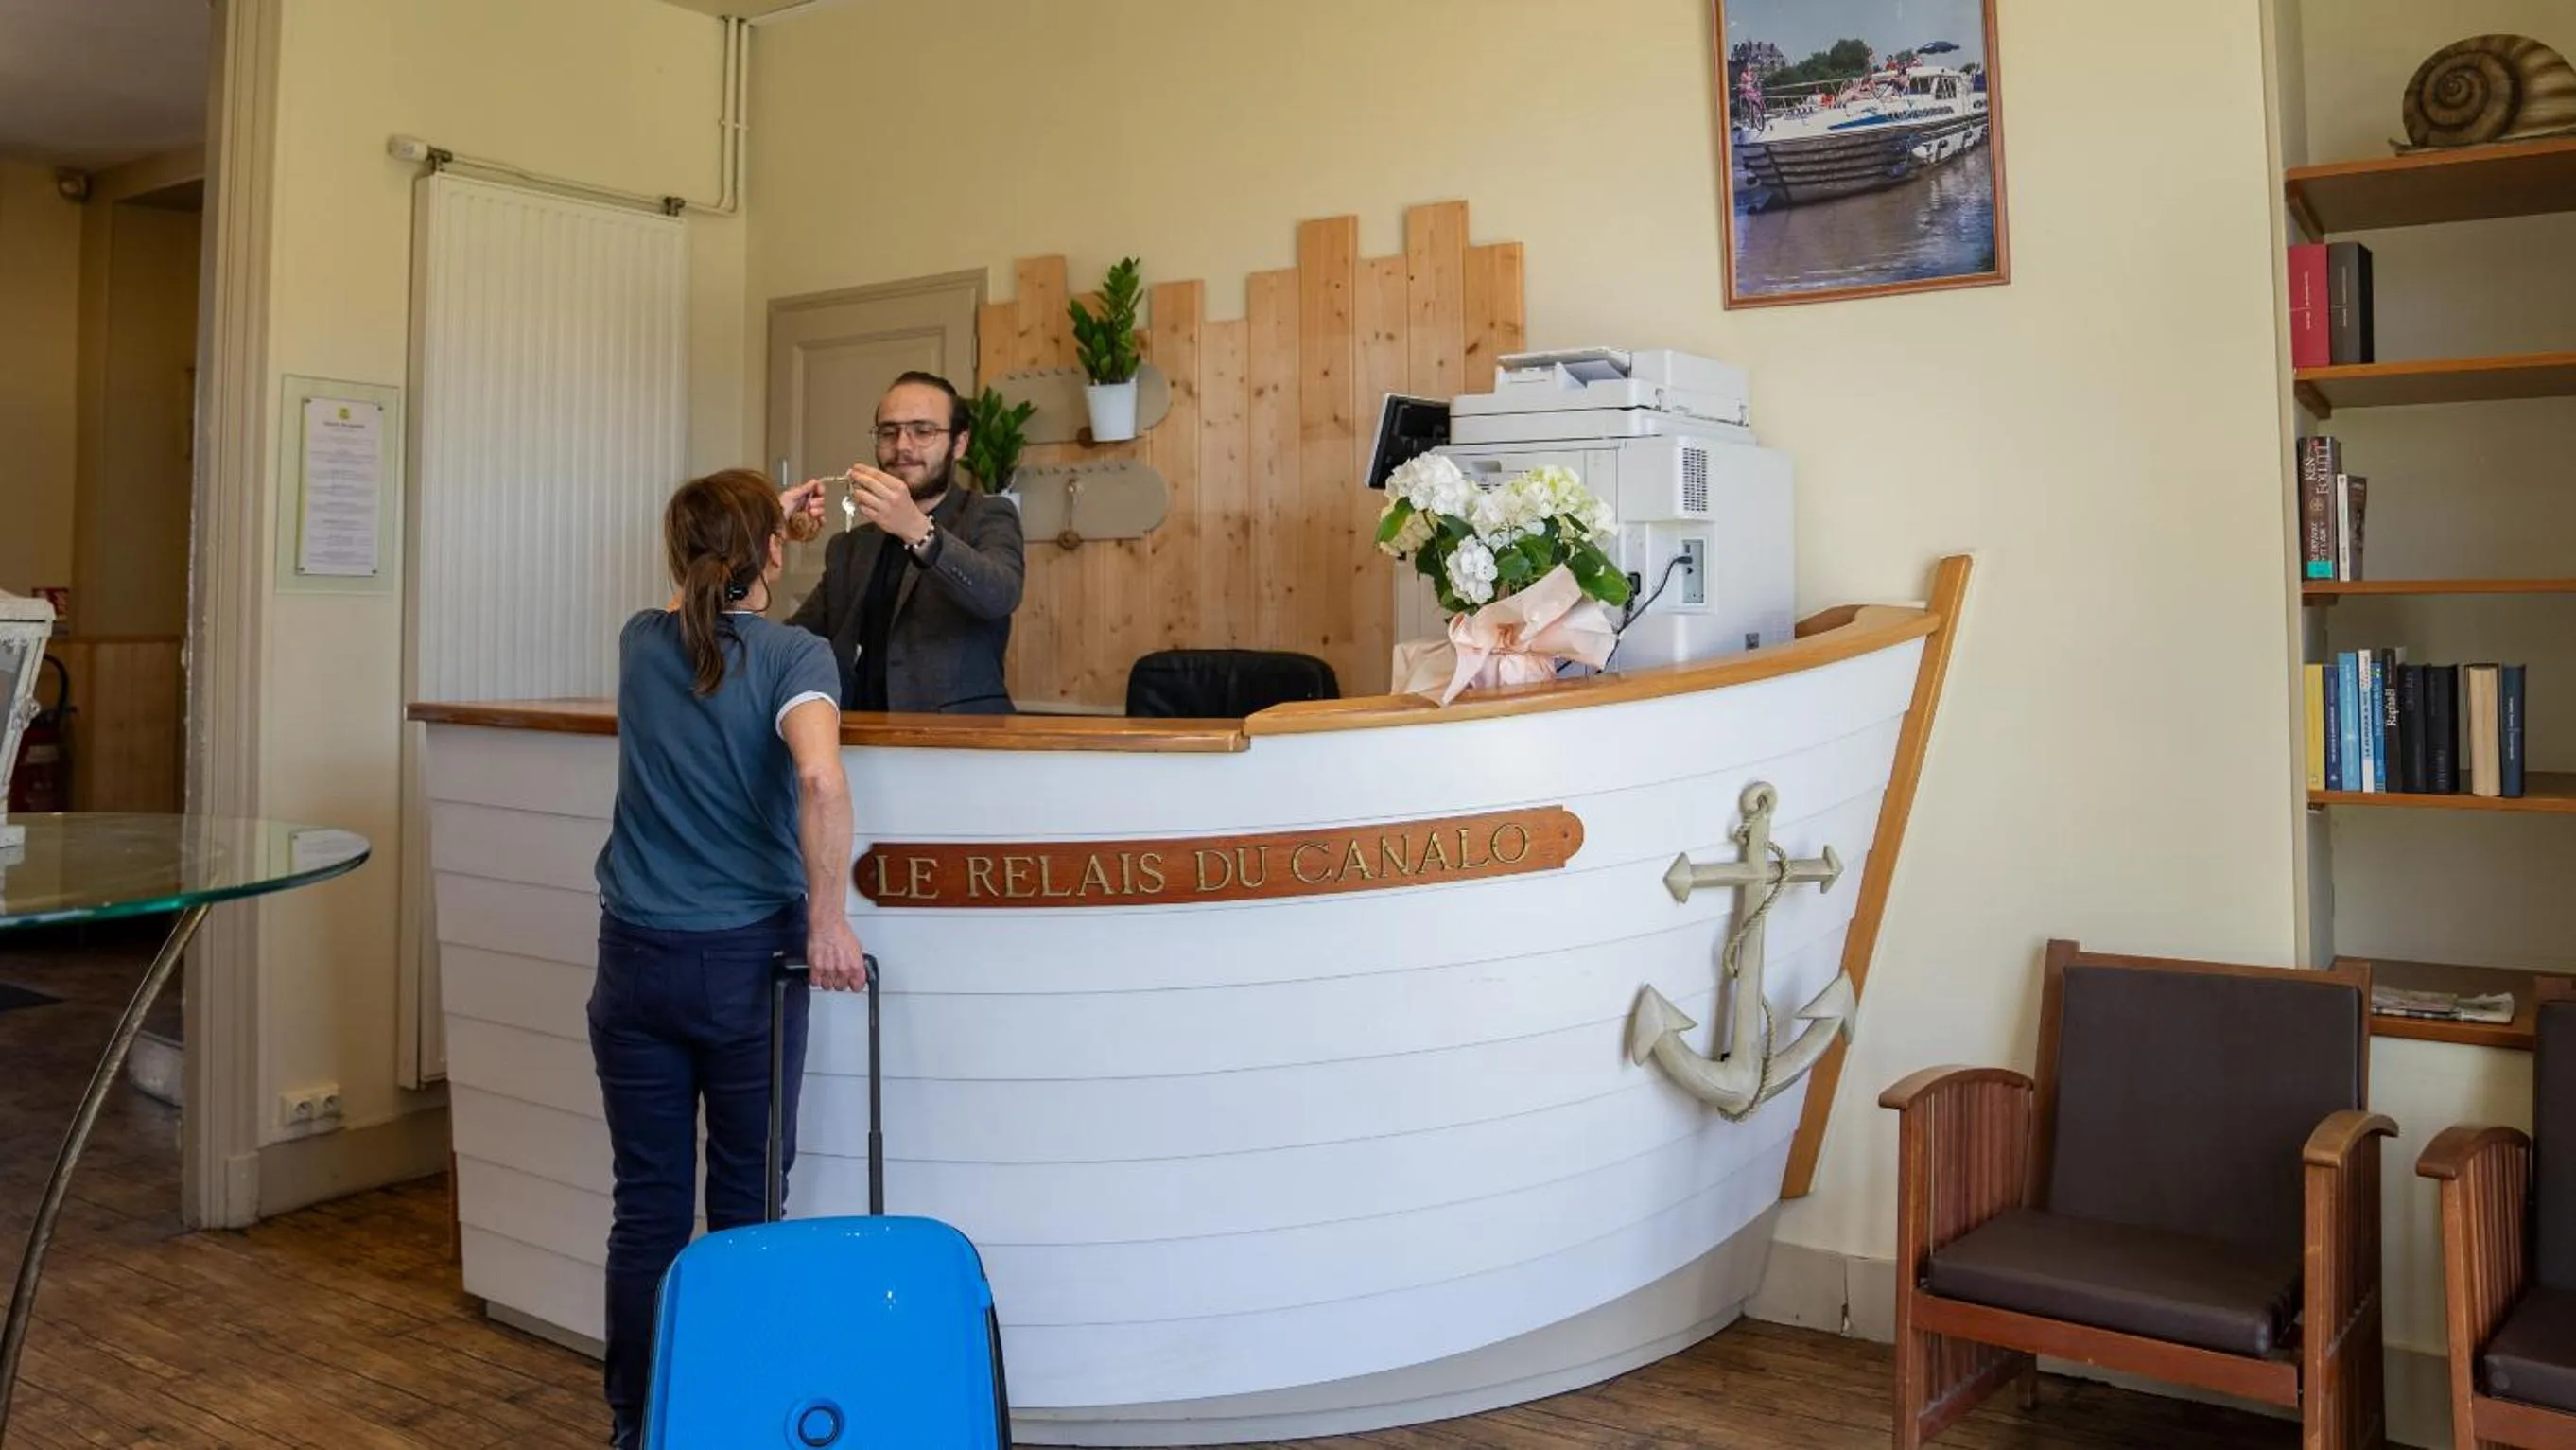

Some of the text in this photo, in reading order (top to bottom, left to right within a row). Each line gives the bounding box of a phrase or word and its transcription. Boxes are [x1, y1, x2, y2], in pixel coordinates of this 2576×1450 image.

[875, 822, 1531, 900] LE RELAIS DU CANALO
